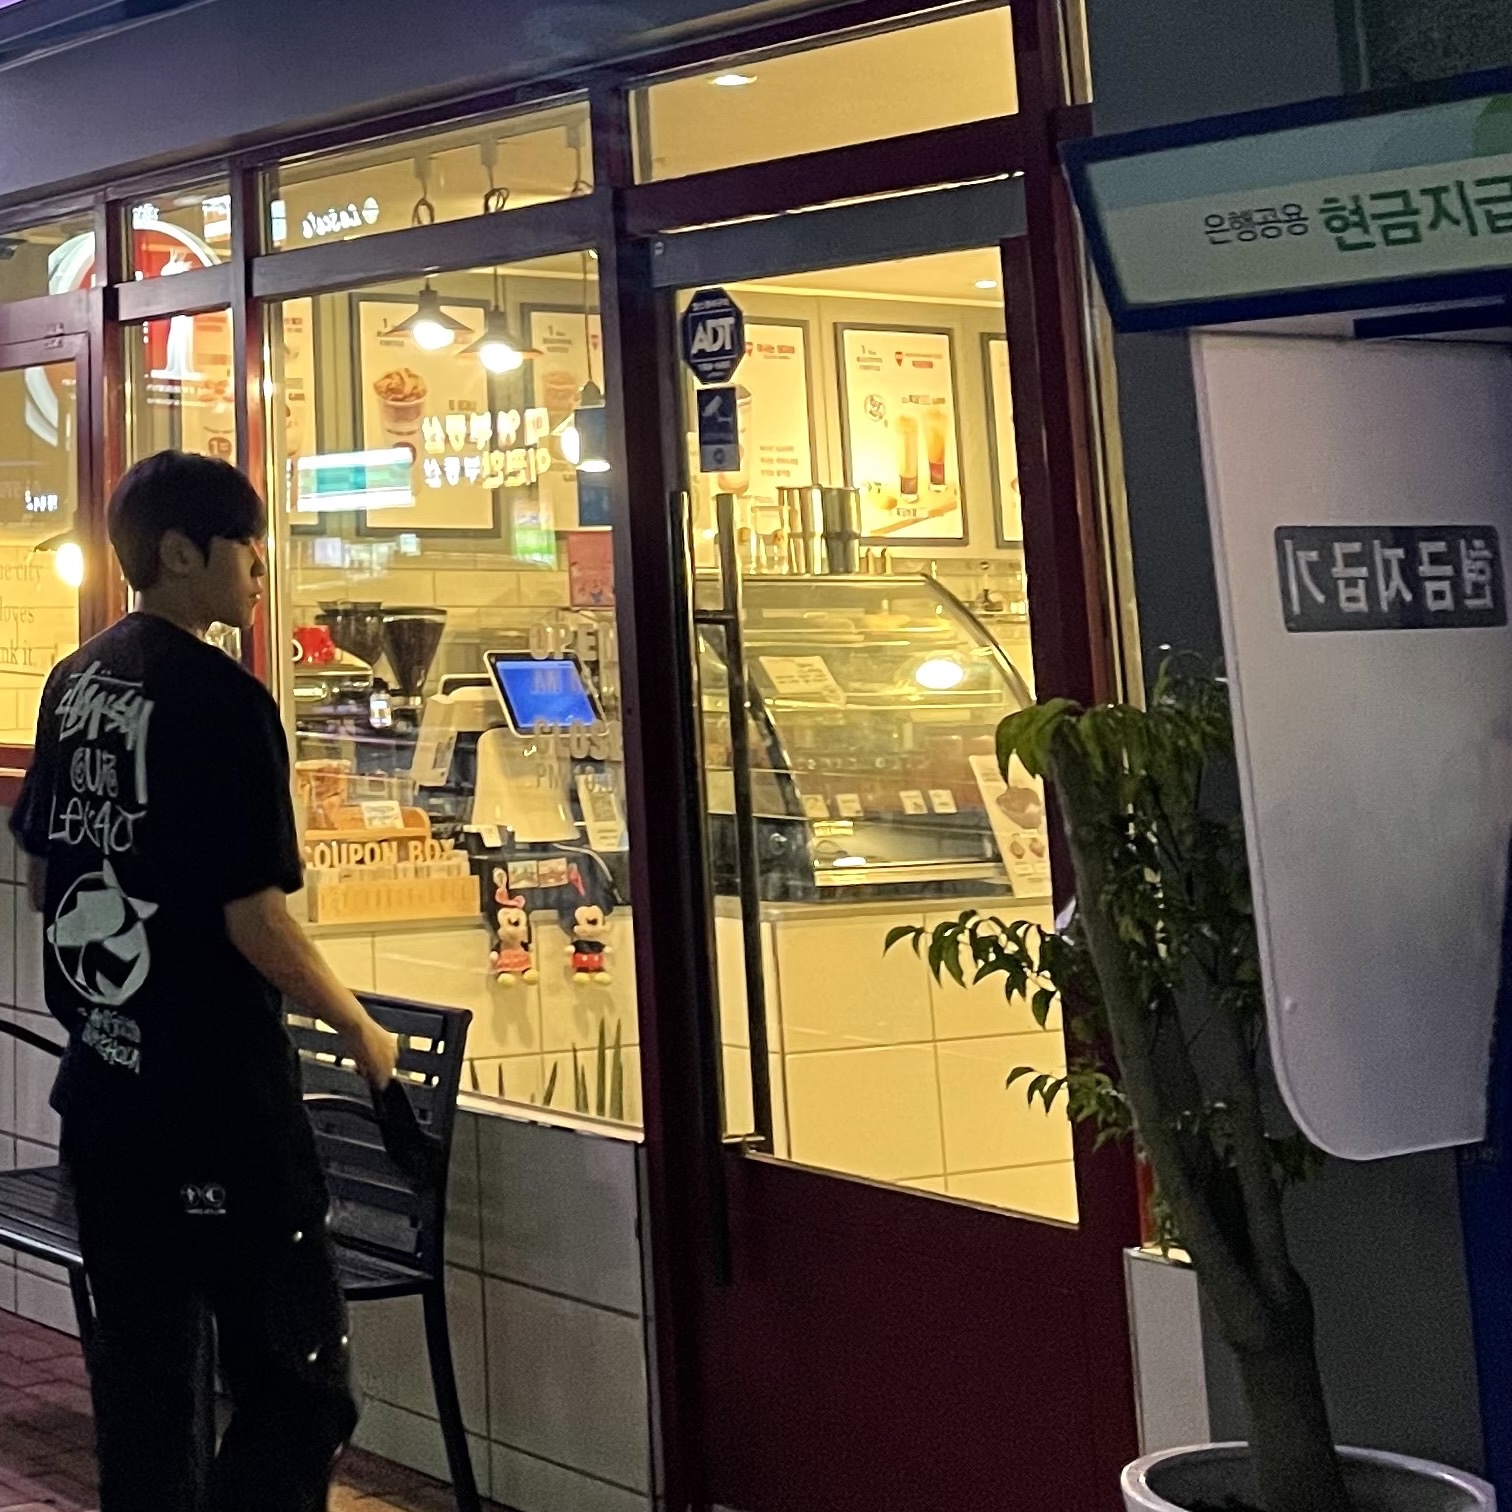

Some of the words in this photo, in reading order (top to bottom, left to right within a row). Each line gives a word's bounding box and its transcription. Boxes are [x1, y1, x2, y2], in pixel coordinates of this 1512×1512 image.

[1204, 202, 1309, 246] 은행공용
[691, 317, 736, 355] ADT
[0, 595, 35, 624] loves
